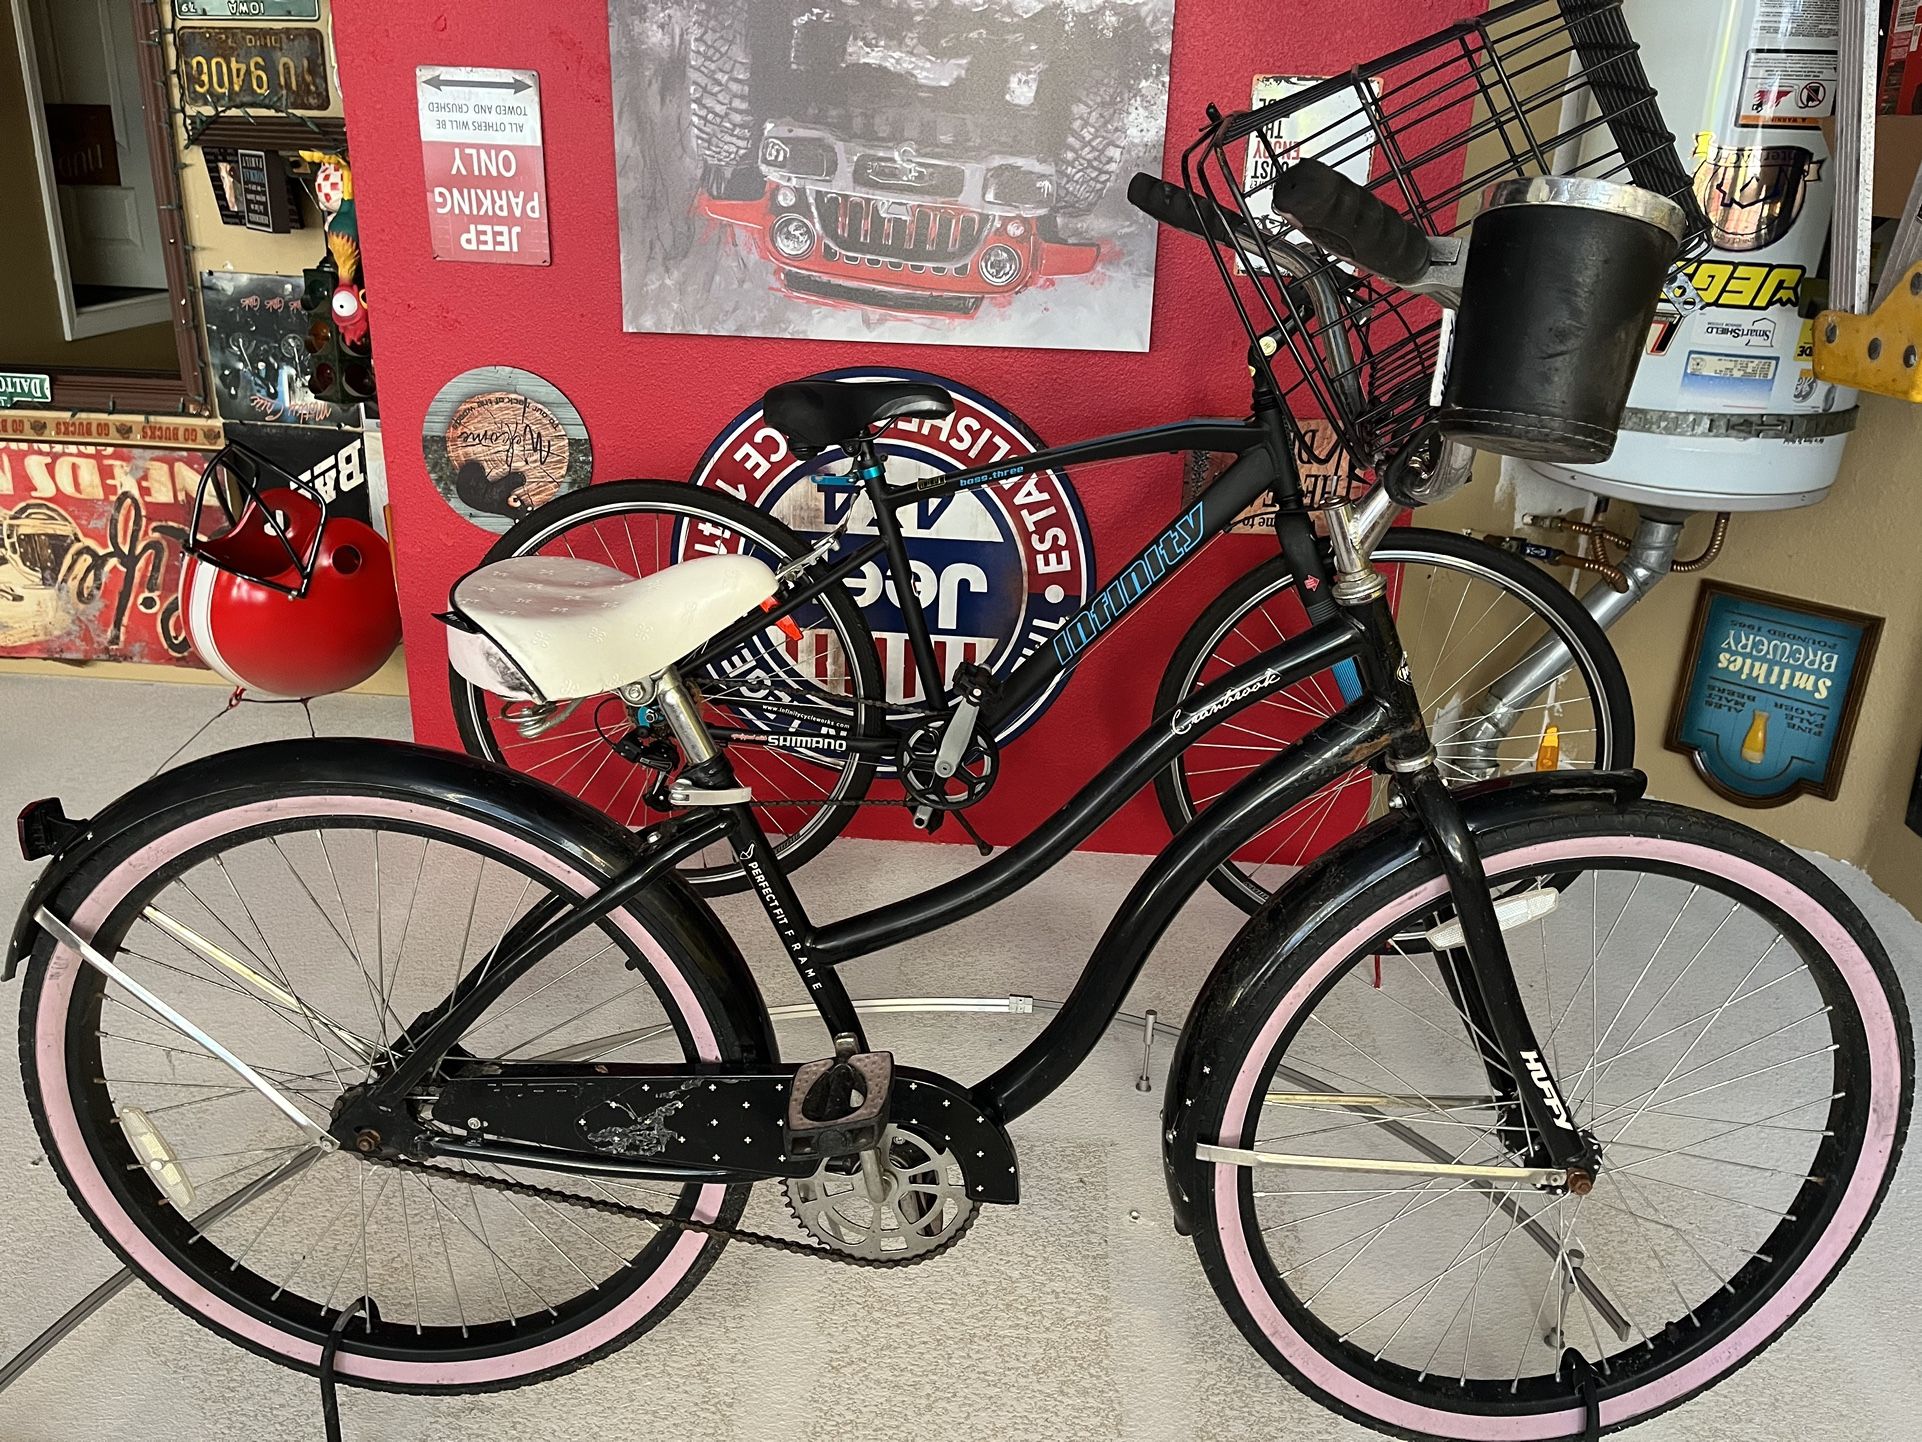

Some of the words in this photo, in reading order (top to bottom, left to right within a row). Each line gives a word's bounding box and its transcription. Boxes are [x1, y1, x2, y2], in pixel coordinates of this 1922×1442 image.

[180, 2, 197, 12] 79
[228, 2, 264, 14] IOWA
[428, 102, 469, 114] CRUSHED
[473, 104, 494, 115] AND
[495, 104, 528, 116] TOWED
[436, 119, 448, 130] BE
[449, 120, 470, 131] WILL
[472, 120, 506, 132] OTHERS
[508, 122, 524, 133] ALL
[1256, 120, 1283, 139] TH
[451, 148, 516, 178] ONLY
[434, 186, 540, 218] PARKING
[460, 224, 522, 252] JEEP
[12, 419, 25, 434] GO
[54, 421, 92, 437] BUCKS
[96, 422, 110, 437] GO
[141, 426, 180, 442] BUCKS
[184, 428, 198, 442] GO
[460, 423, 550, 467] Welcome
[811, 545, 988, 629] Jee
[1720, 629, 1838, 673] BREWERY
[1718, 652, 1832, 700] Smithies
[1170, 668, 1282, 734] Cranbrook
[1706, 684, 1756, 702] BEERS
[1706, 692, 1746, 708] MALT
[1704, 700, 1744, 714] ALES
[1774, 701, 1828, 720] LAGER
[1784, 713, 1824, 729] PALE
[768, 735, 847, 750] SHIMANO
[748, 862, 778, 908] PERFECT
[774, 907, 788, 926] FIT
[784, 930, 822, 990] FRAME
[1520, 1050, 1574, 1130] HUFFY
